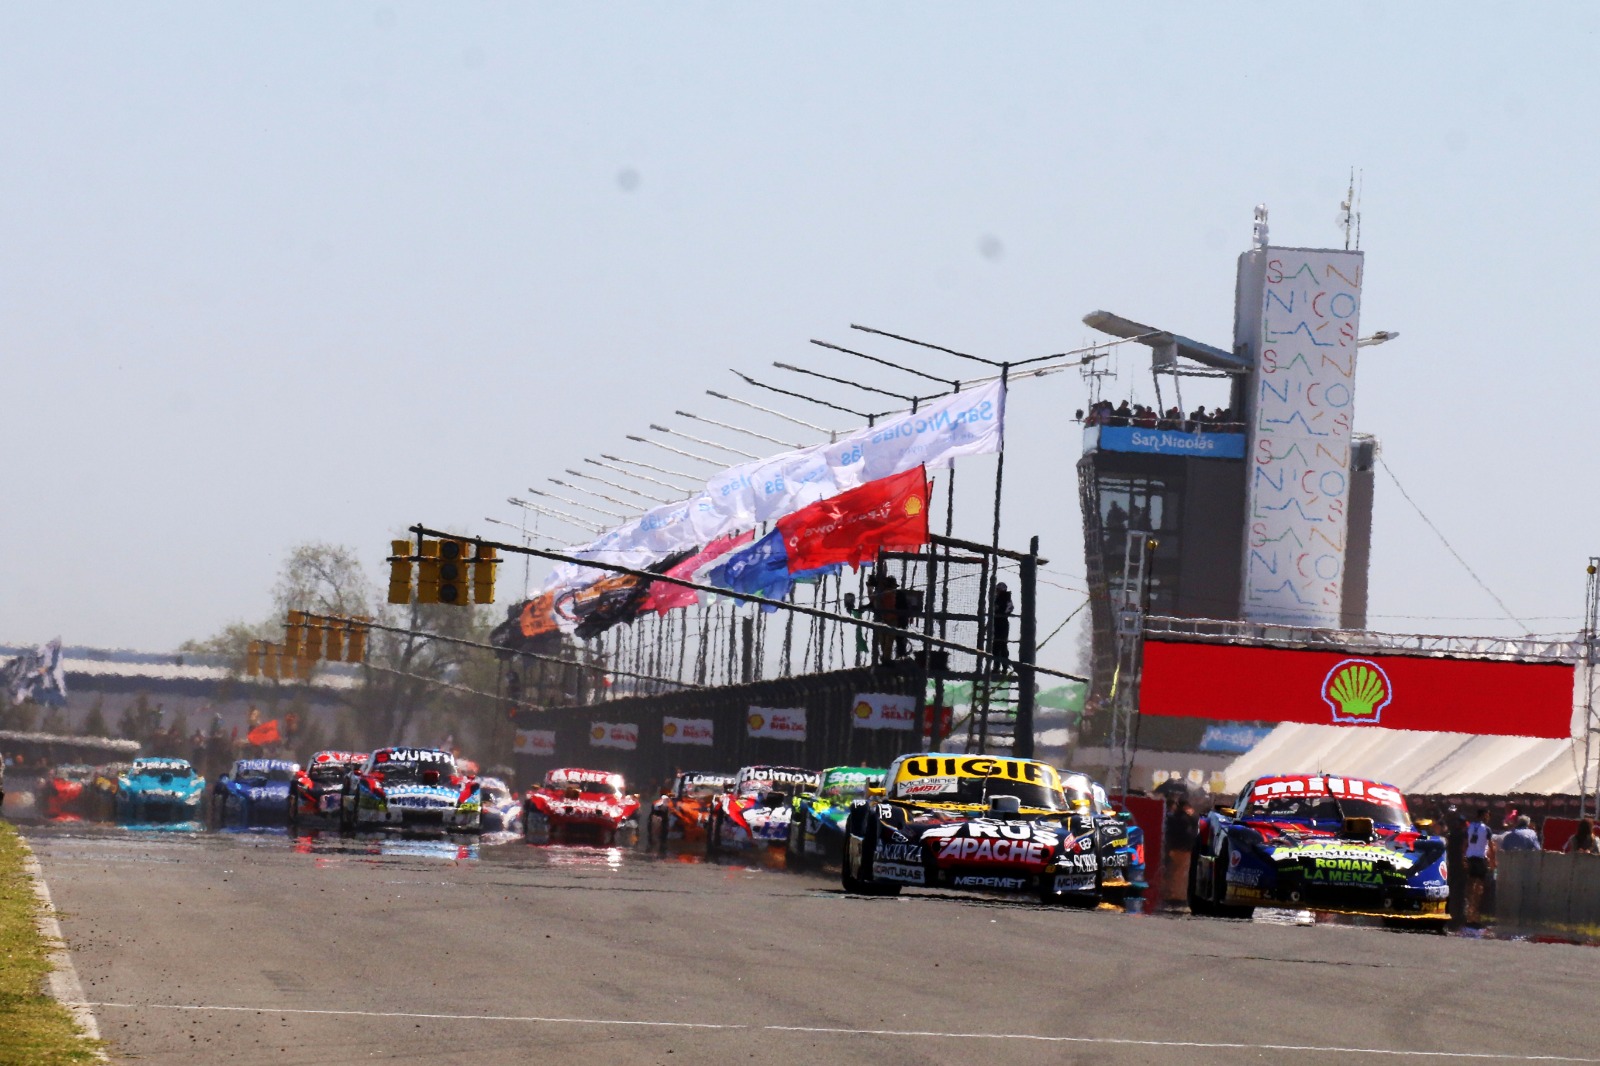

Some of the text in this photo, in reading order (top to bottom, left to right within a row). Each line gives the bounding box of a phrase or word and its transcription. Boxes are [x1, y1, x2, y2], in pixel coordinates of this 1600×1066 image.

[1267, 259, 1360, 288] SAN
[1266, 288, 1356, 319] NICO
[1262, 349, 1353, 378] SAN
[1262, 379, 1350, 408] NICO
[1132, 432, 1214, 451] San Nicolás
[1256, 439, 1348, 468] SAN
[1255, 466, 1345, 497] NICO
[1251, 522, 1344, 552] SAN
[938, 837, 1044, 863] APACHE
[1315, 858, 1373, 871] ROMAN
[954, 876, 1026, 889] MEDEMET
[1303, 868, 1325, 880] LA
[1329, 870, 1384, 885] MENZA
